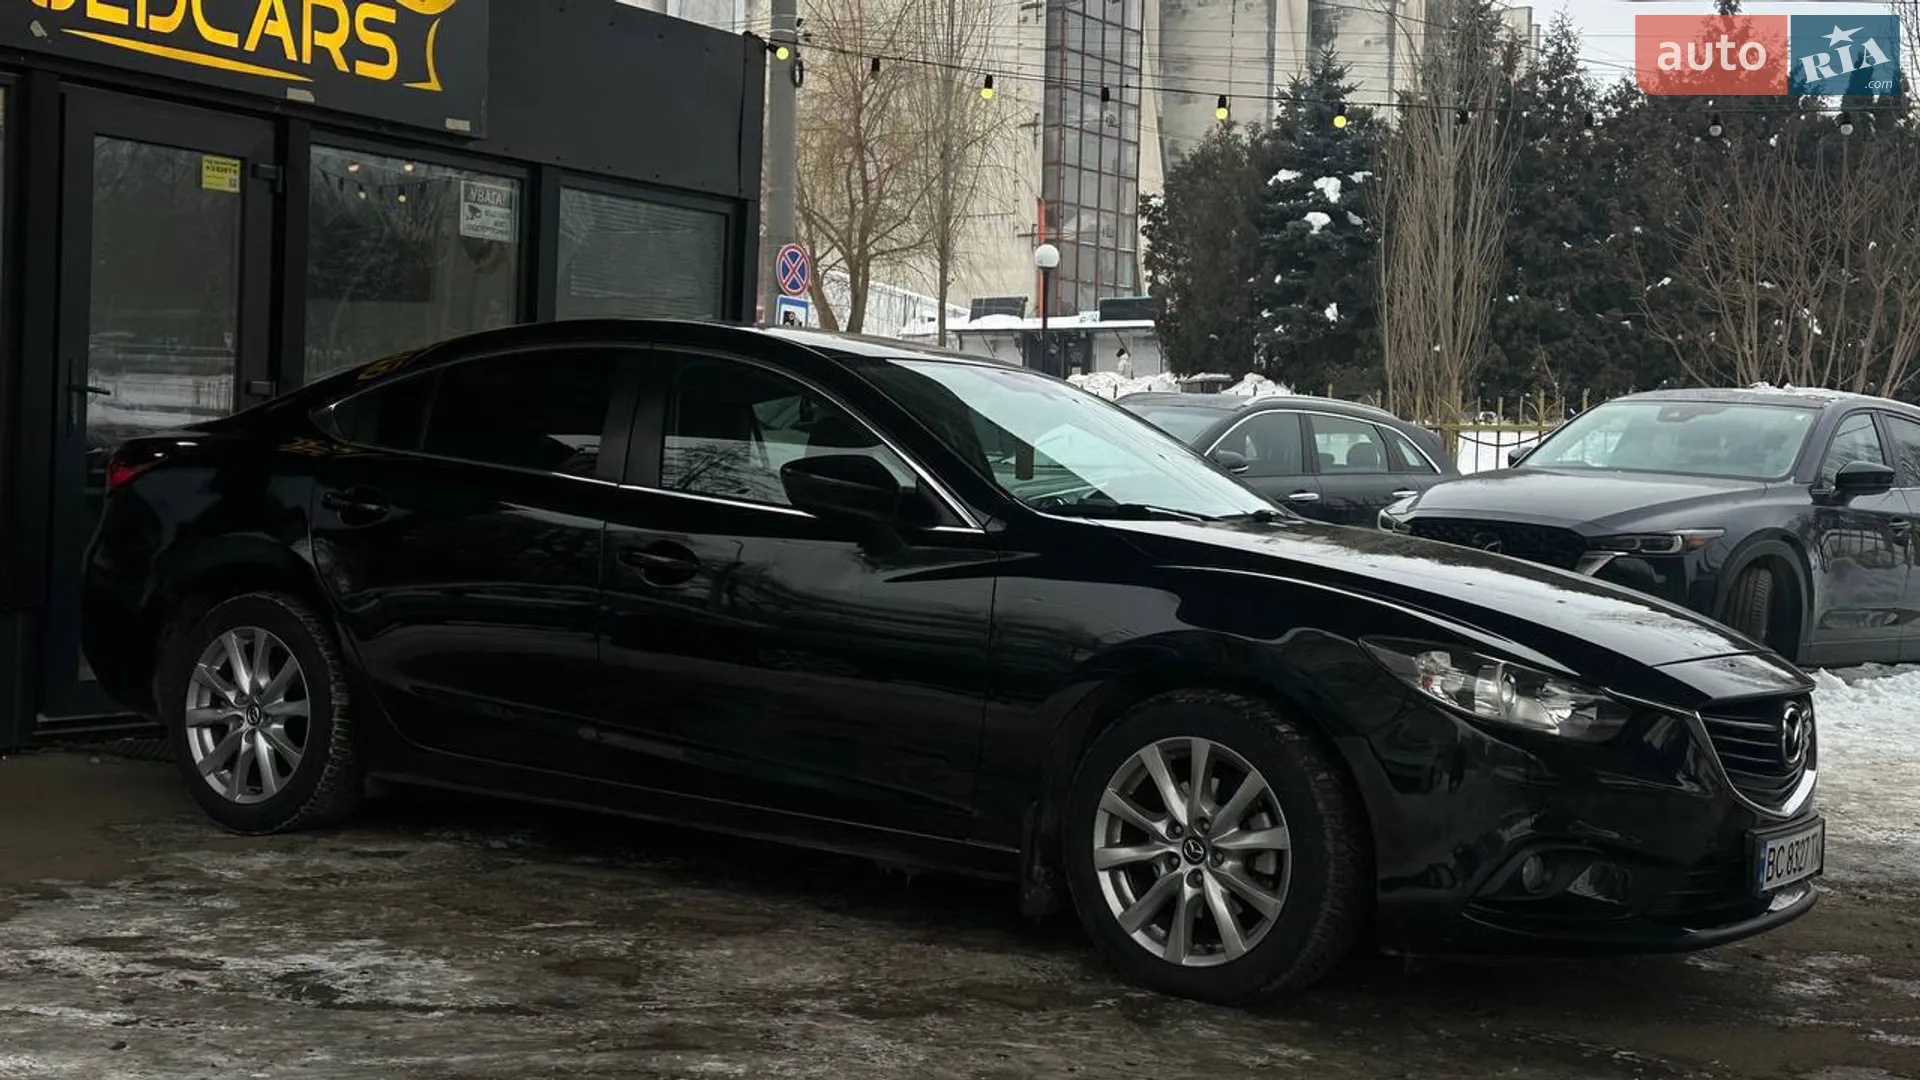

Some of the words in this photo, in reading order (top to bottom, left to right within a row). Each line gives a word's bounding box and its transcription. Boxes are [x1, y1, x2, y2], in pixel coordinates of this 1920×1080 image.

[29, 0, 399, 81] CARS
[1766, 845, 1785, 882] BC
[1786, 835, 1810, 876] 8327
